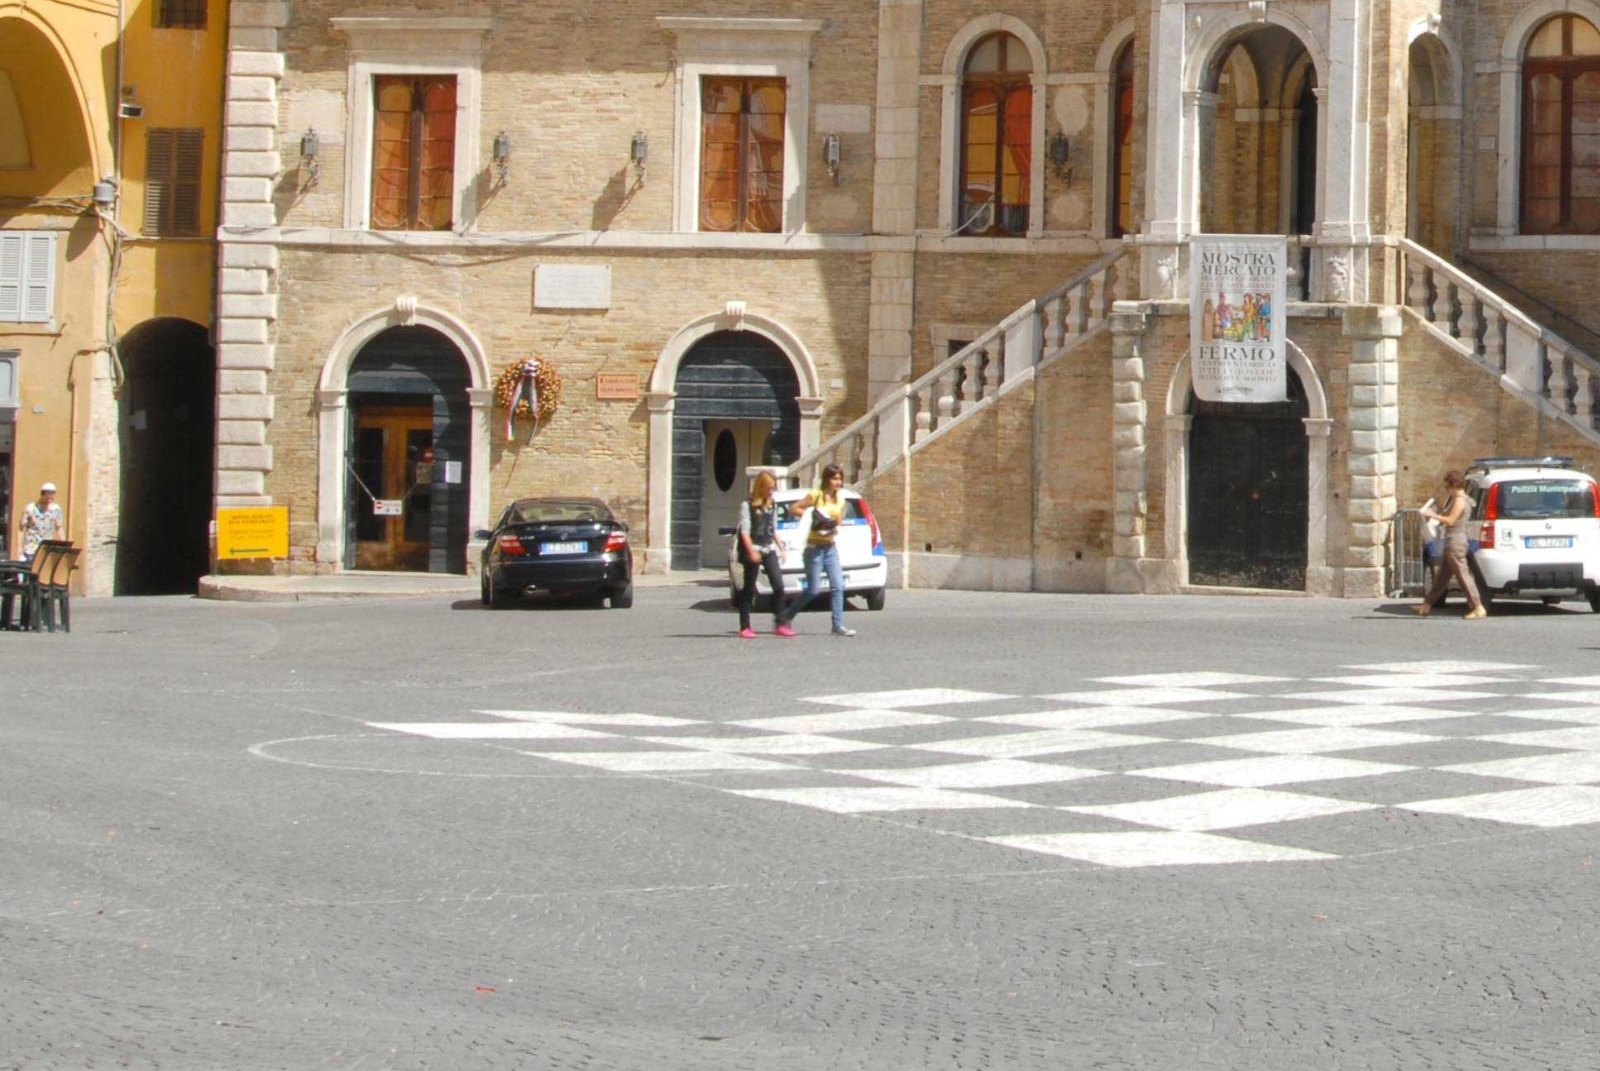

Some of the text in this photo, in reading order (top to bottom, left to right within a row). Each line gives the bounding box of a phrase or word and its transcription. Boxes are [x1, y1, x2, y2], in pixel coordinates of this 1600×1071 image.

[1202, 252, 1275, 265] MOSTRA
[1201, 265, 1276, 276] MERCATO
[1199, 346, 1275, 362] FERMO
[1511, 485, 1538, 493] Polizia
